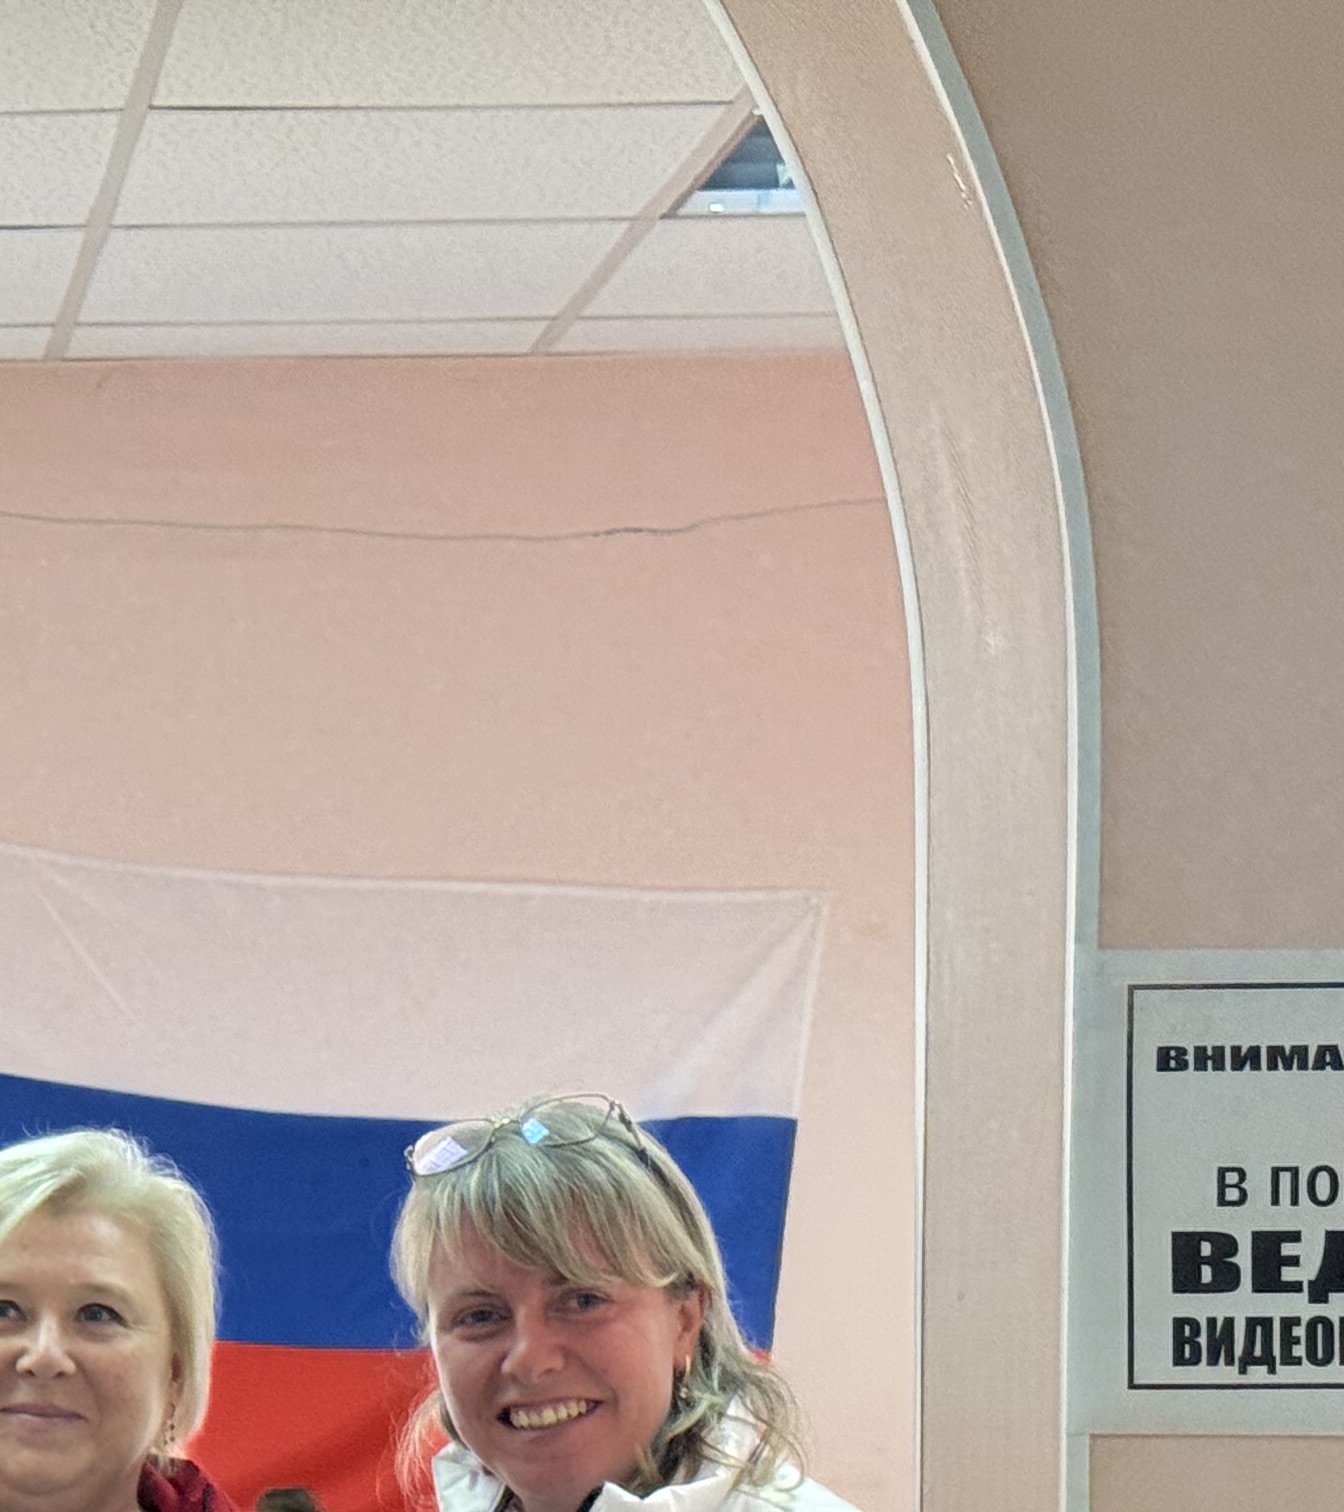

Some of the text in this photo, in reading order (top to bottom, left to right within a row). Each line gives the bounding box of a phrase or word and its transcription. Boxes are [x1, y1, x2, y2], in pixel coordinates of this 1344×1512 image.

[1156, 1045, 1344, 1072] ВНИМА
[1216, 1165, 1341, 1208] В ПО
